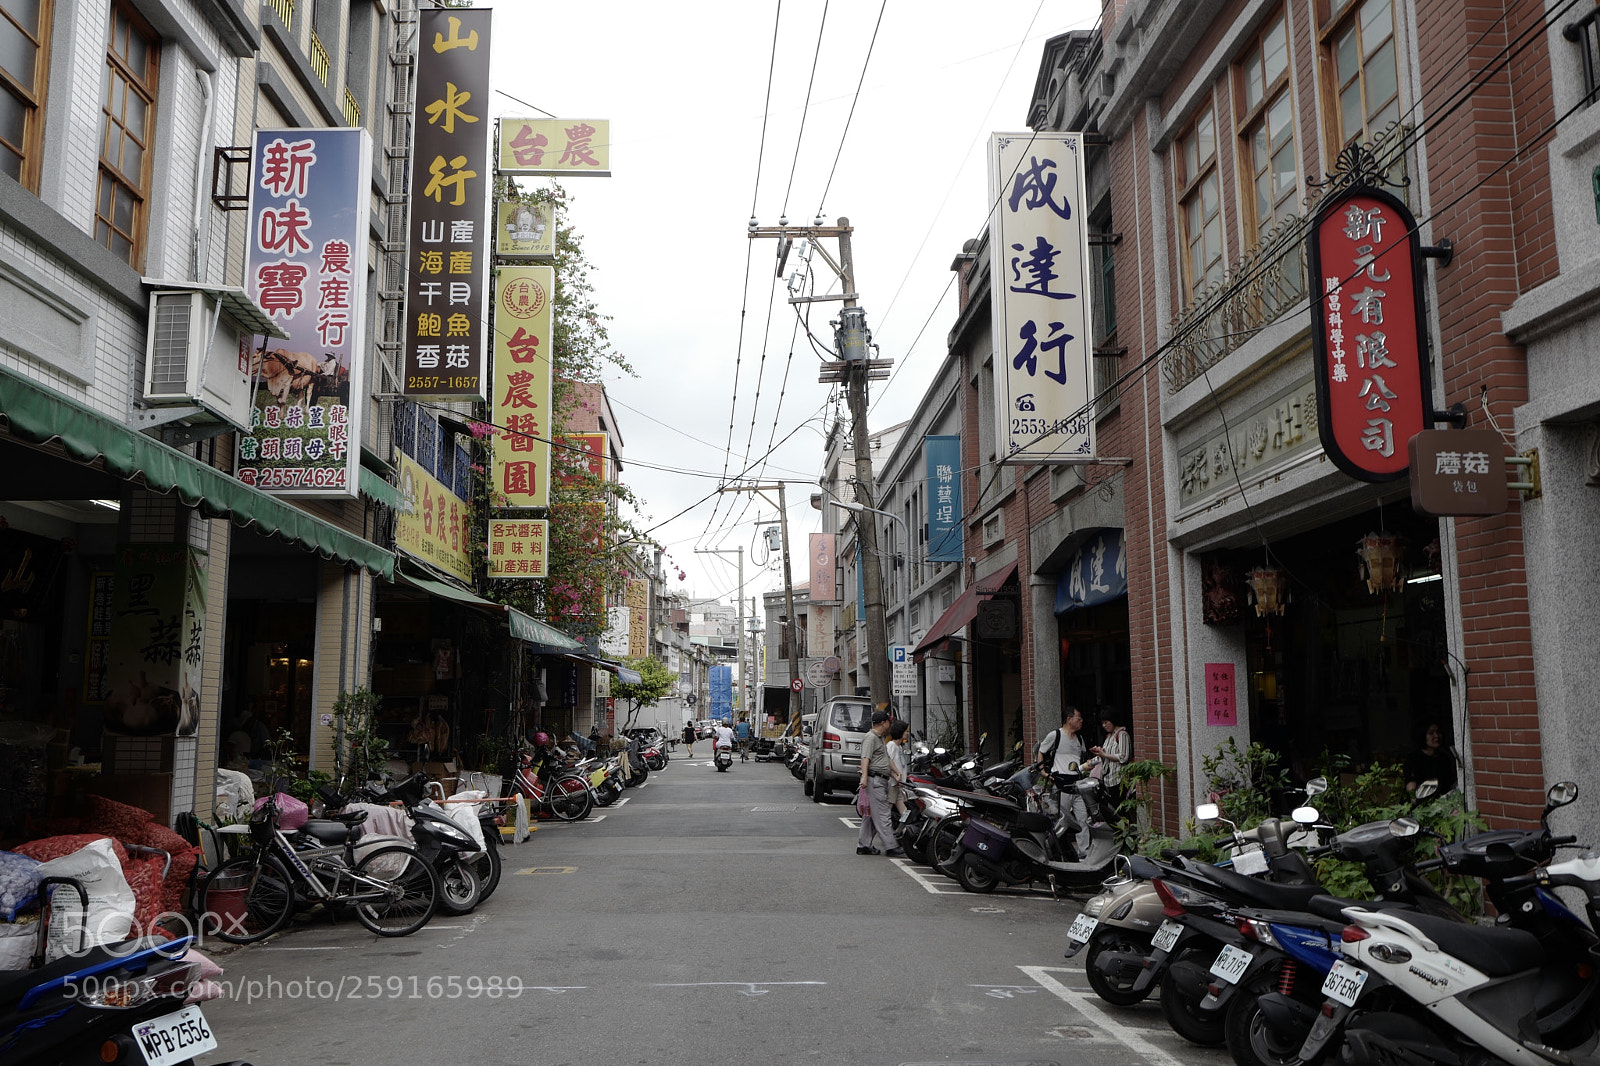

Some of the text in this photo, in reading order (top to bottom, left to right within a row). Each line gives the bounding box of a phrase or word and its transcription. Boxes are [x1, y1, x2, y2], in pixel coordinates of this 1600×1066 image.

[424, 16, 479, 206] 山水行
[509, 123, 600, 167] 台農
[258, 141, 314, 317] 新味寶
[1009, 156, 1076, 385] 成達行
[419, 282, 471, 306] 干貝
[416, 312, 470, 337] 鮑魚
[1325, 276, 1348, 383] 勝昌科學中藥
[1342, 205, 1398, 458] 新元有限公司
[416, 344, 470, 369] 香菇
[408, 376, 478, 388] 2557-1657
[501, 326, 540, 497] 台農醬園
[1012, 418, 1086, 435] 2553-4836
[1435, 451, 1489, 475] 蘑菇
[262, 468, 346, 486] 25574624
[1453, 480, 1478, 493] 袋包
[493, 523, 542, 538] 各式醬菜
[492, 560, 542, 574] 山產海產
[896, 650, 903, 660] P
[282, 846, 311, 879] PATRIOT
